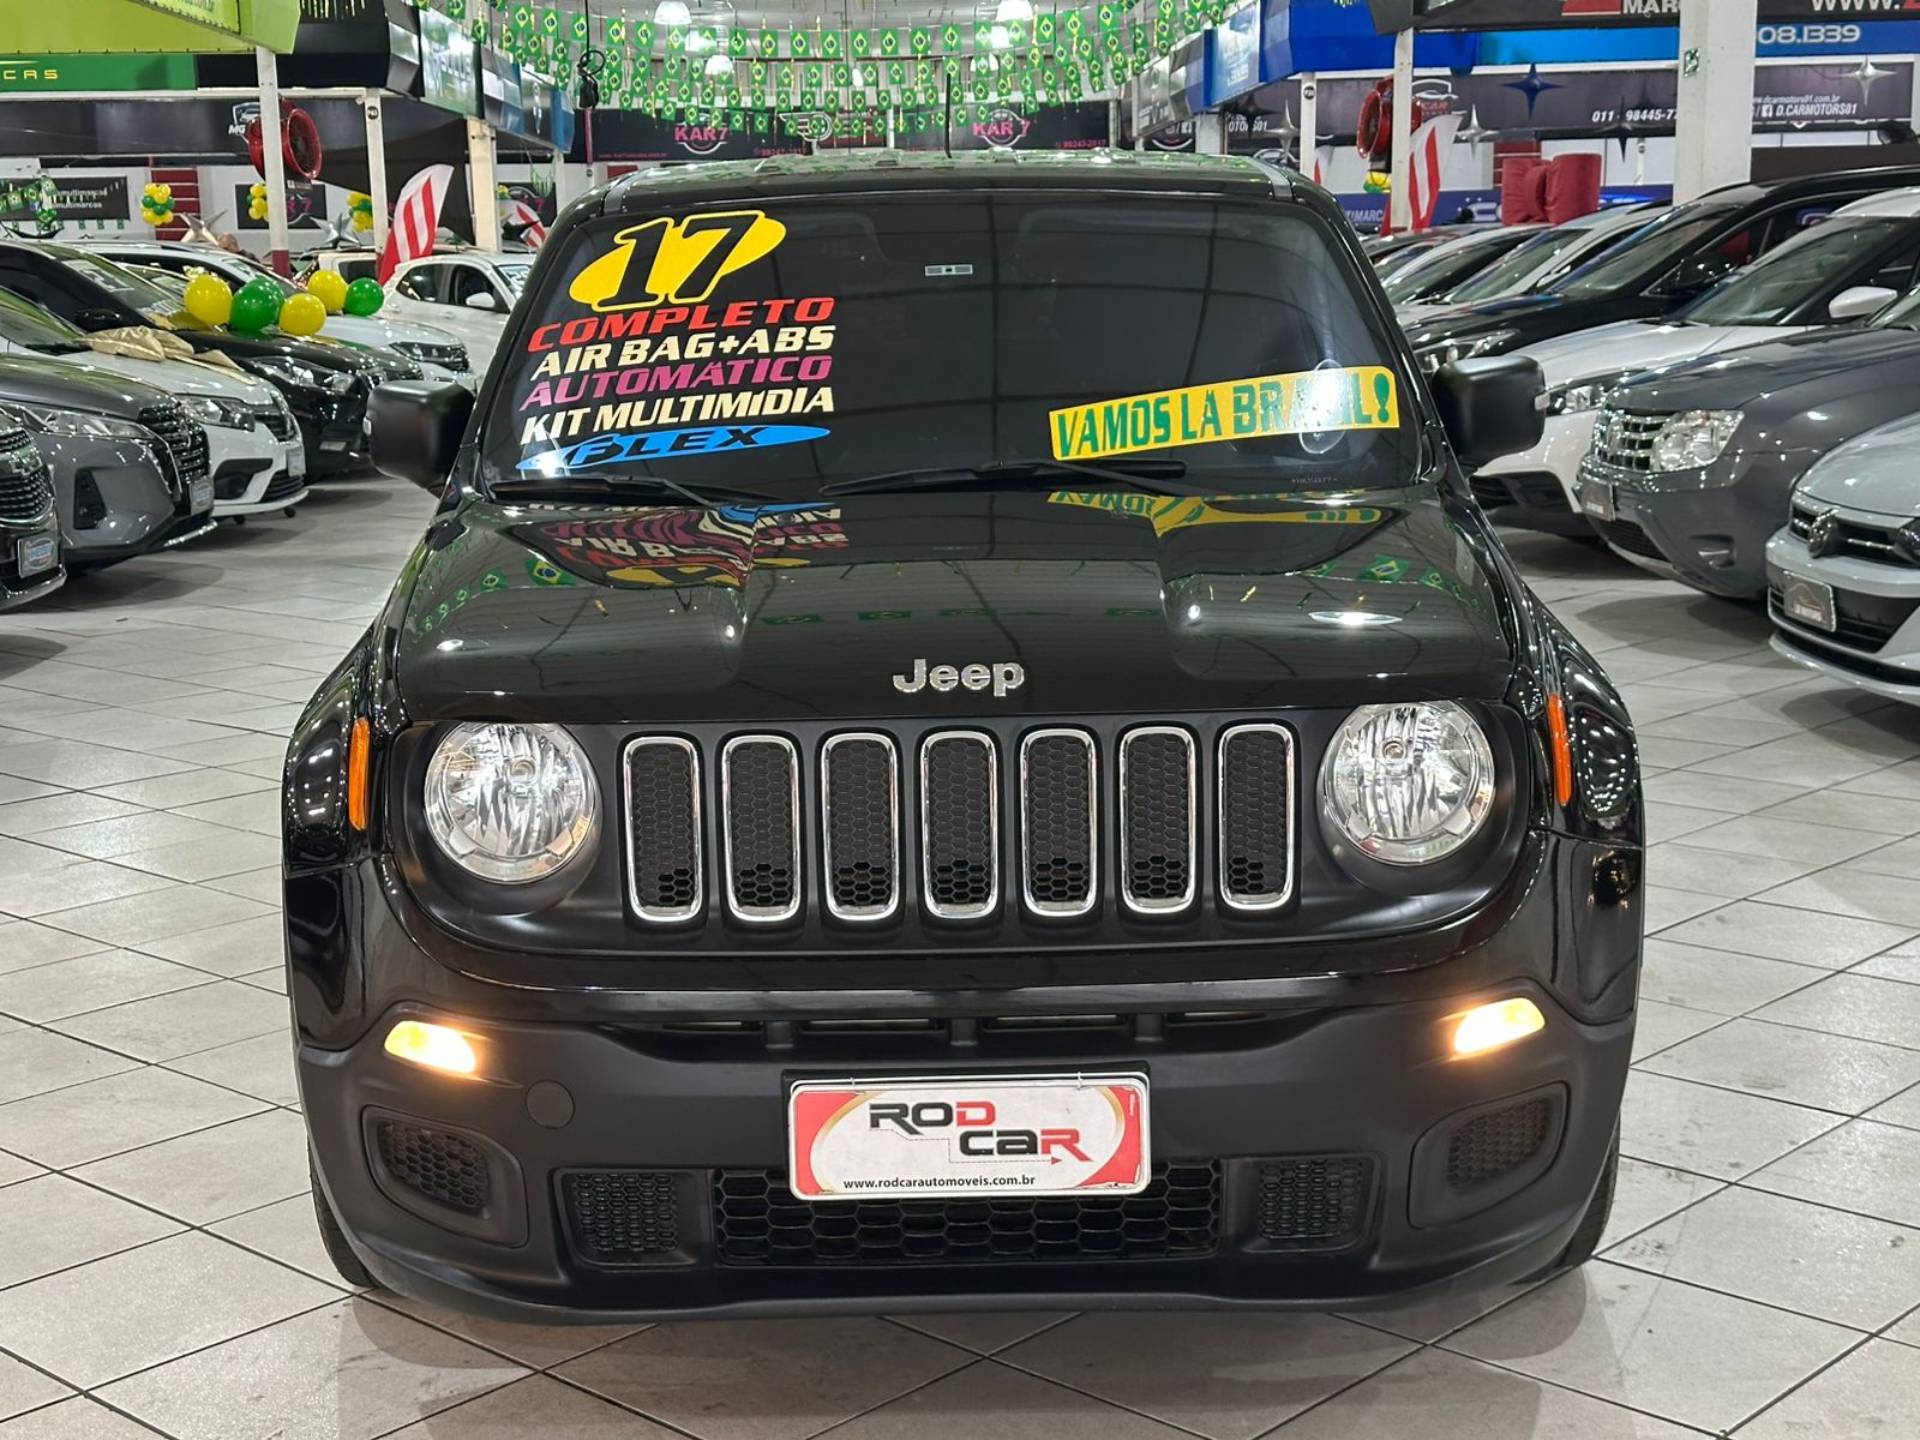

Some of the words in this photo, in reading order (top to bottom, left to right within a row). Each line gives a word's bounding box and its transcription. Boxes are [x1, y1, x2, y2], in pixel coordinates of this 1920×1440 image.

[1622, 0, 1681, 14] MAR
[673, 126, 717, 142] KAR
[972, 122, 1014, 136] KAR
[592, 210, 766, 312] 17
[528, 297, 835, 352] COMPLETO
[530, 342, 613, 381] AIR
[617, 325, 836, 366] BAG+ABS
[520, 407, 592, 446] KIT
[1057, 395, 1171, 457] VAMOS
[1232, 372, 1390, 434] BRAIL!
[566, 427, 770, 467] FLEX
[892, 658, 1025, 697] Jeep
[868, 1100, 996, 1136] ROD
[843, 1174, 1036, 1190] www.rodcarautomoveis.com.br
